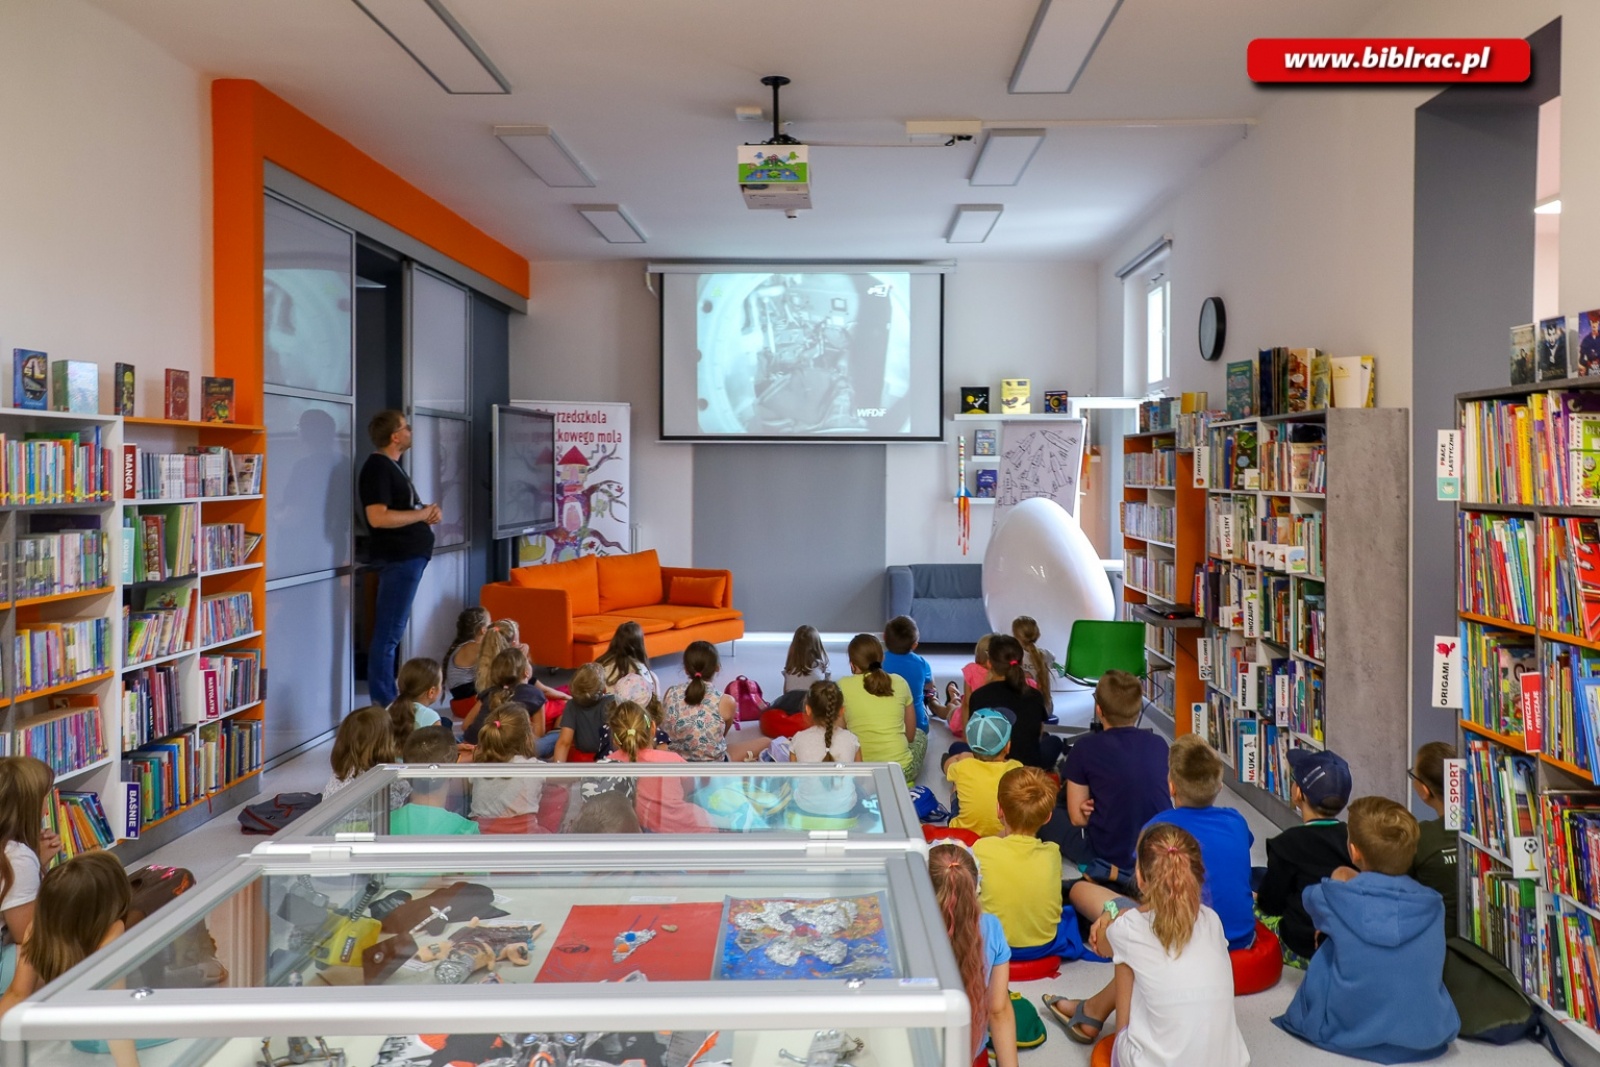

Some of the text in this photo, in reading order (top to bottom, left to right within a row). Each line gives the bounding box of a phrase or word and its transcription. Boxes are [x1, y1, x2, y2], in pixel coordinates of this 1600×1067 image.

[557, 410, 607, 423] rzedszkola
[557, 429, 622, 445] kowego mola
[124, 453, 133, 491] MANGA
[1440, 662, 1449, 706] ORIGAMI
[1524, 692, 1533, 731] ZWYCZAJE
[1449, 762, 1459, 803] SPORT
[129, 790, 137, 827] BAŚNIE
